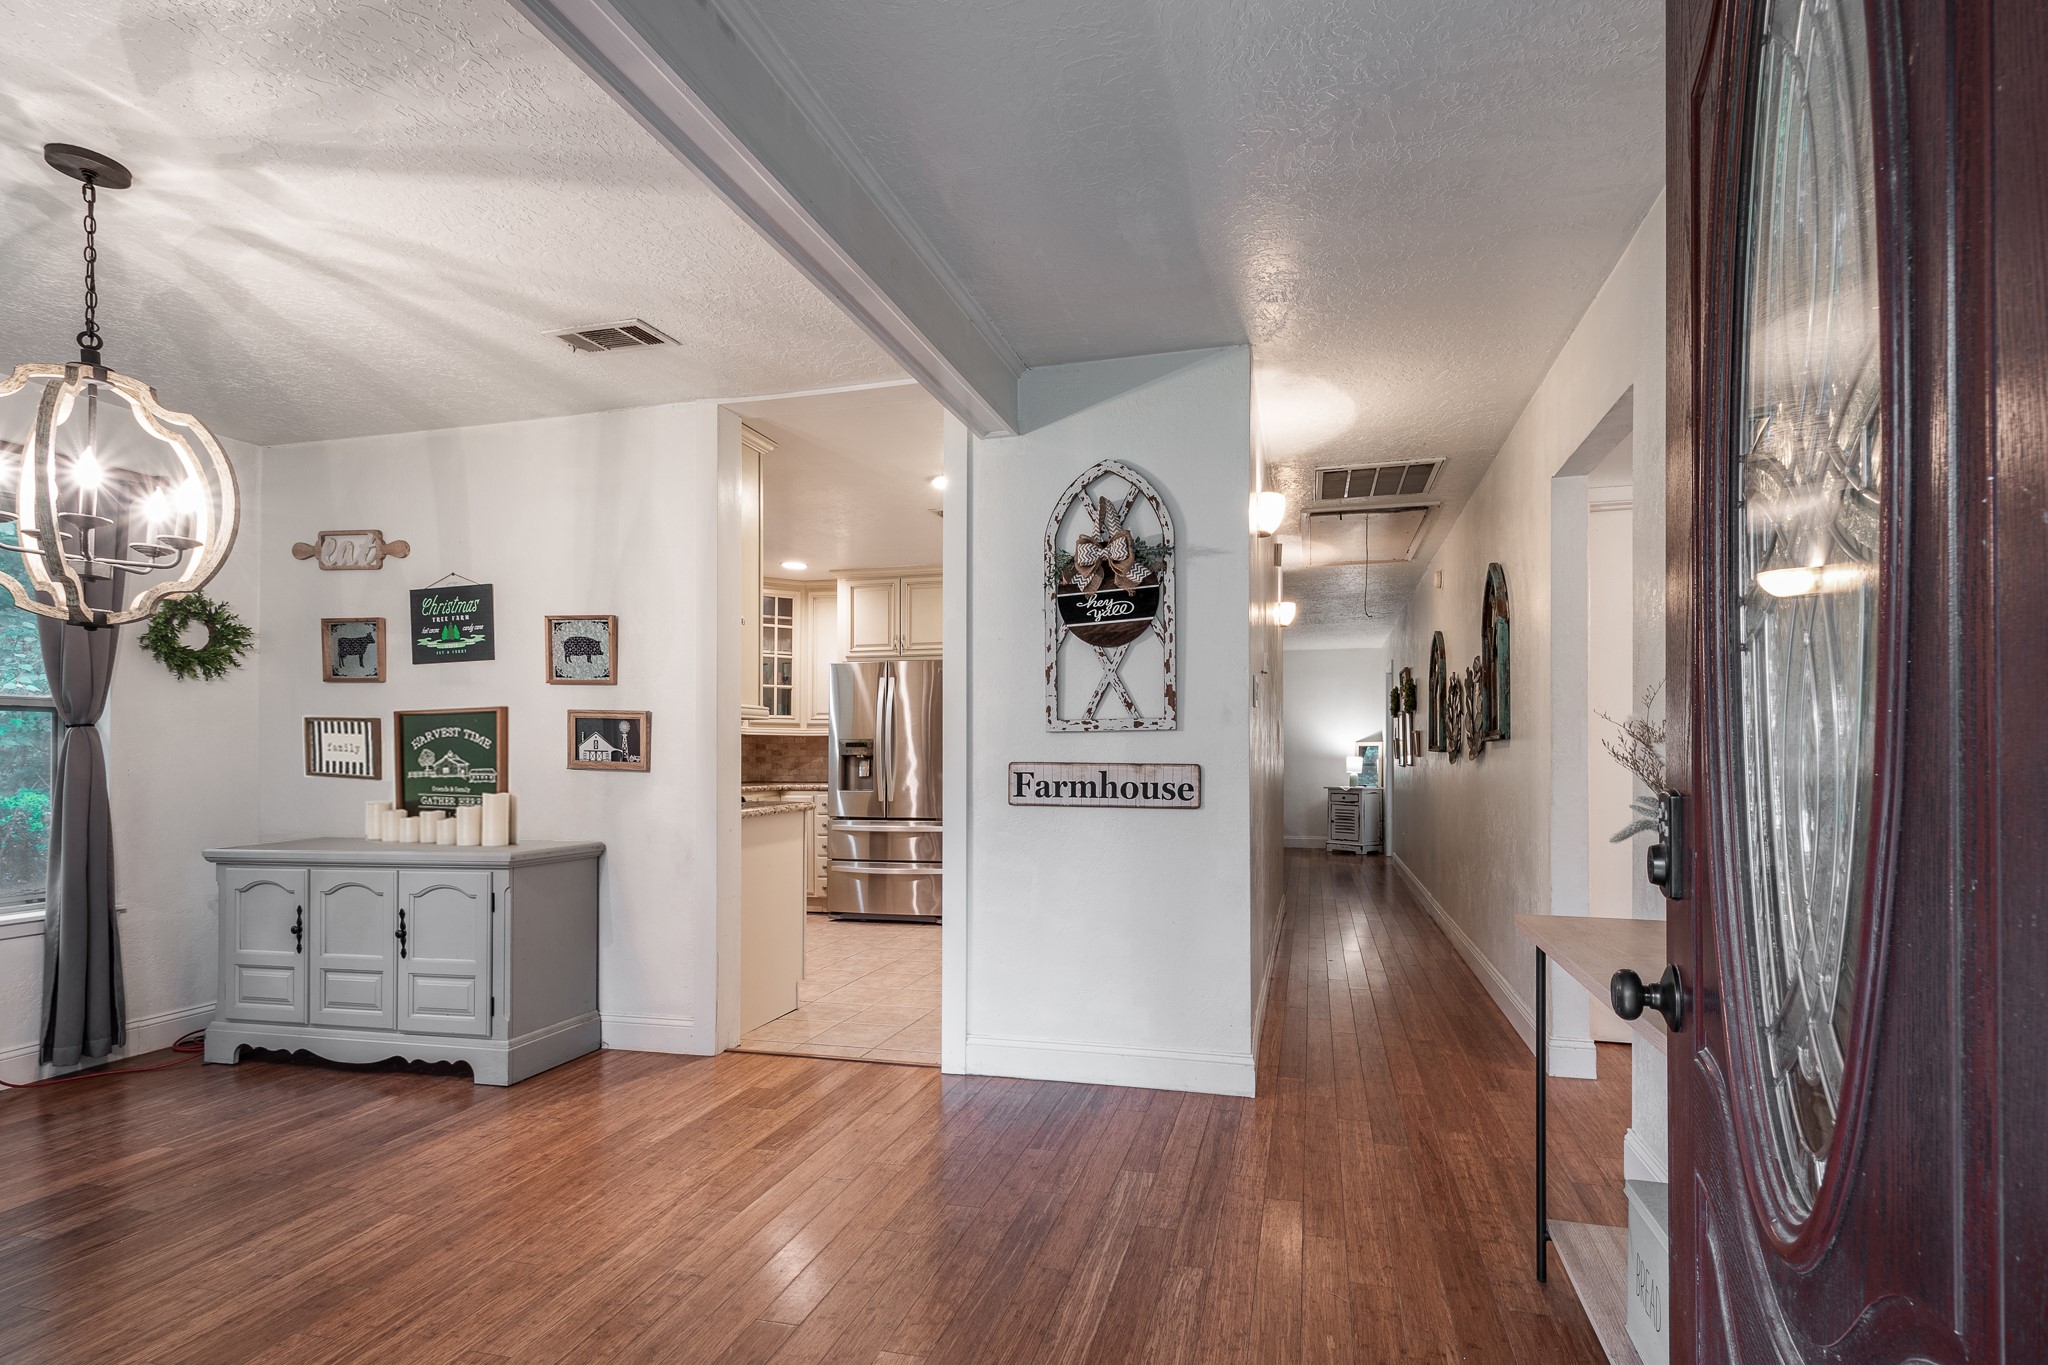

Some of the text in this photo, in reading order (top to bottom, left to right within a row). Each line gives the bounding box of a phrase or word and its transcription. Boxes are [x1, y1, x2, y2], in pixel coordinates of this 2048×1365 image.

[321, 532, 378, 567] eat
[421, 594, 480, 616] Christmas
[1076, 593, 1113, 610] hey
[1086, 600, 1135, 622] y'all
[432, 615, 449, 623] TREE
[327, 742, 361, 755] family
[410, 727, 492, 750] HARVEST TIME
[1012, 770, 1195, 801] Farmhouse
[420, 796, 457, 806] GATHER
[1635, 1251, 1662, 1333] BREAD
